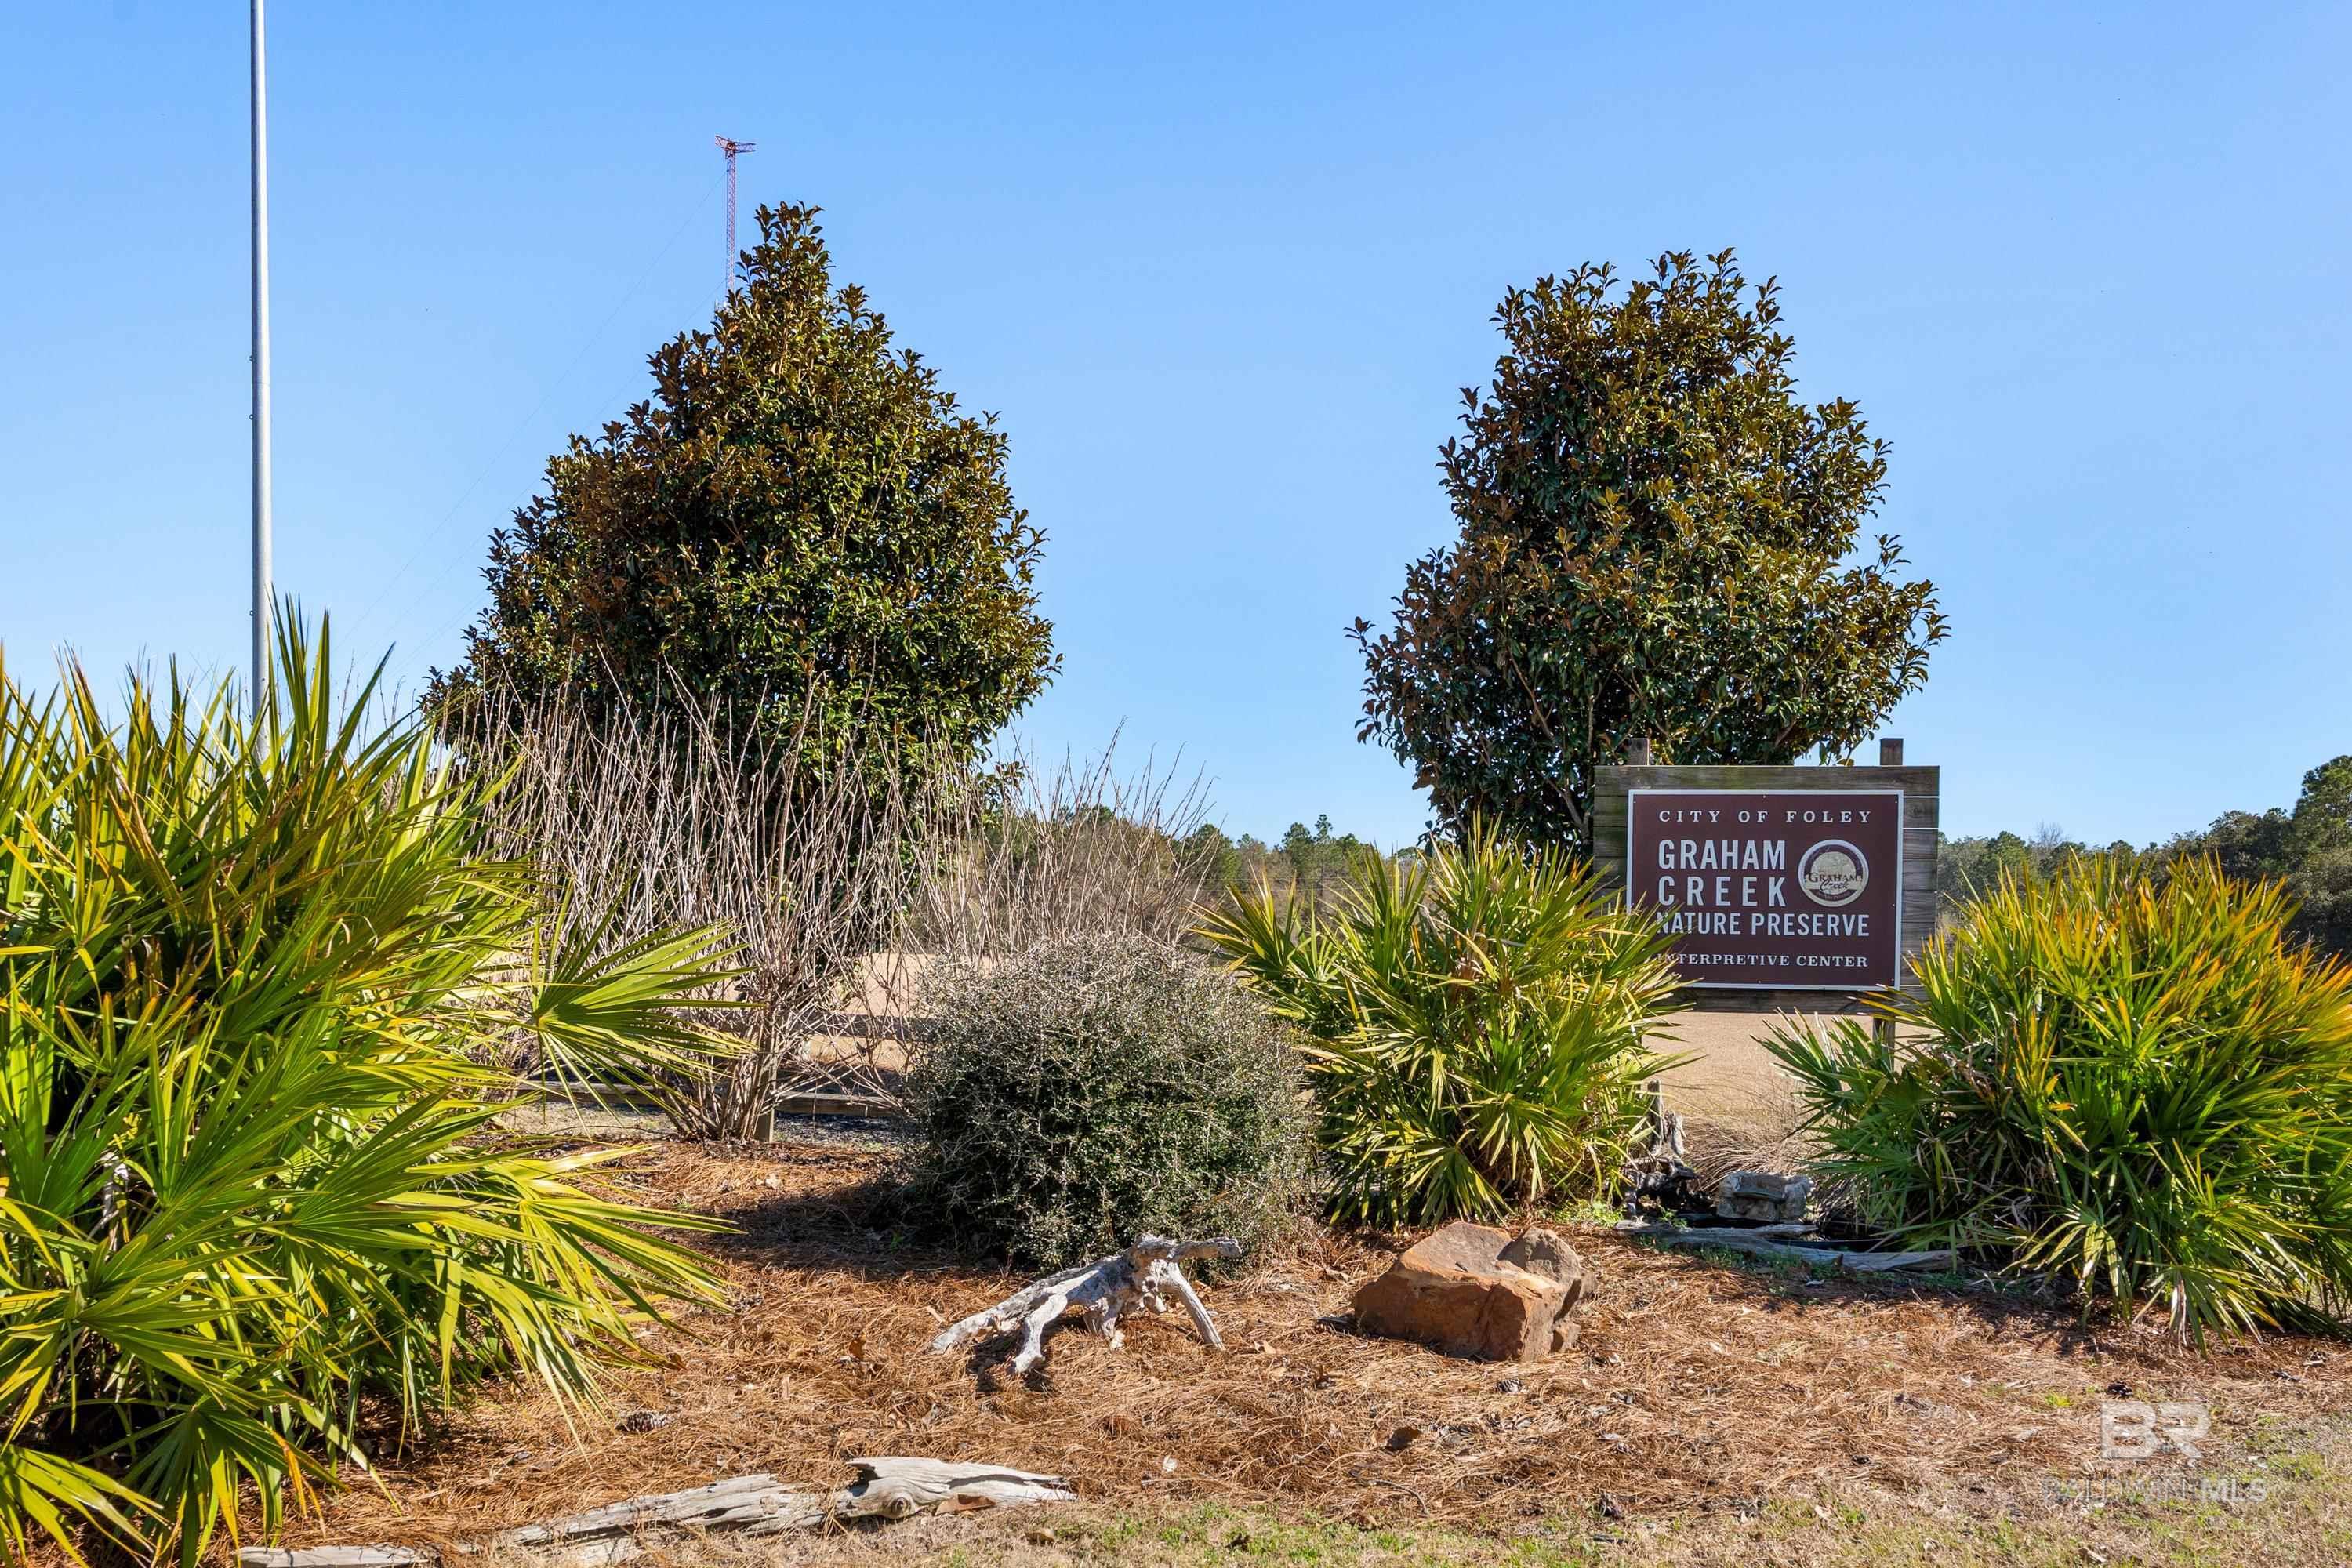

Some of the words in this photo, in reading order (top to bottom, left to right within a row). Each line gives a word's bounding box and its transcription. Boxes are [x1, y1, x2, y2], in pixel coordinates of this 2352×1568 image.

[1658, 810, 1722, 823] CITY
[1737, 810, 1769, 823] OF
[1786, 811, 1871, 823] FOLEY
[1658, 840, 1785, 869] GRAHAM
[1658, 876, 1786, 906] CREEK
[1656, 912, 1741, 935] NATURE
[1751, 913, 1870, 936] PRESERVE
[1796, 956, 1868, 967] CENTER
